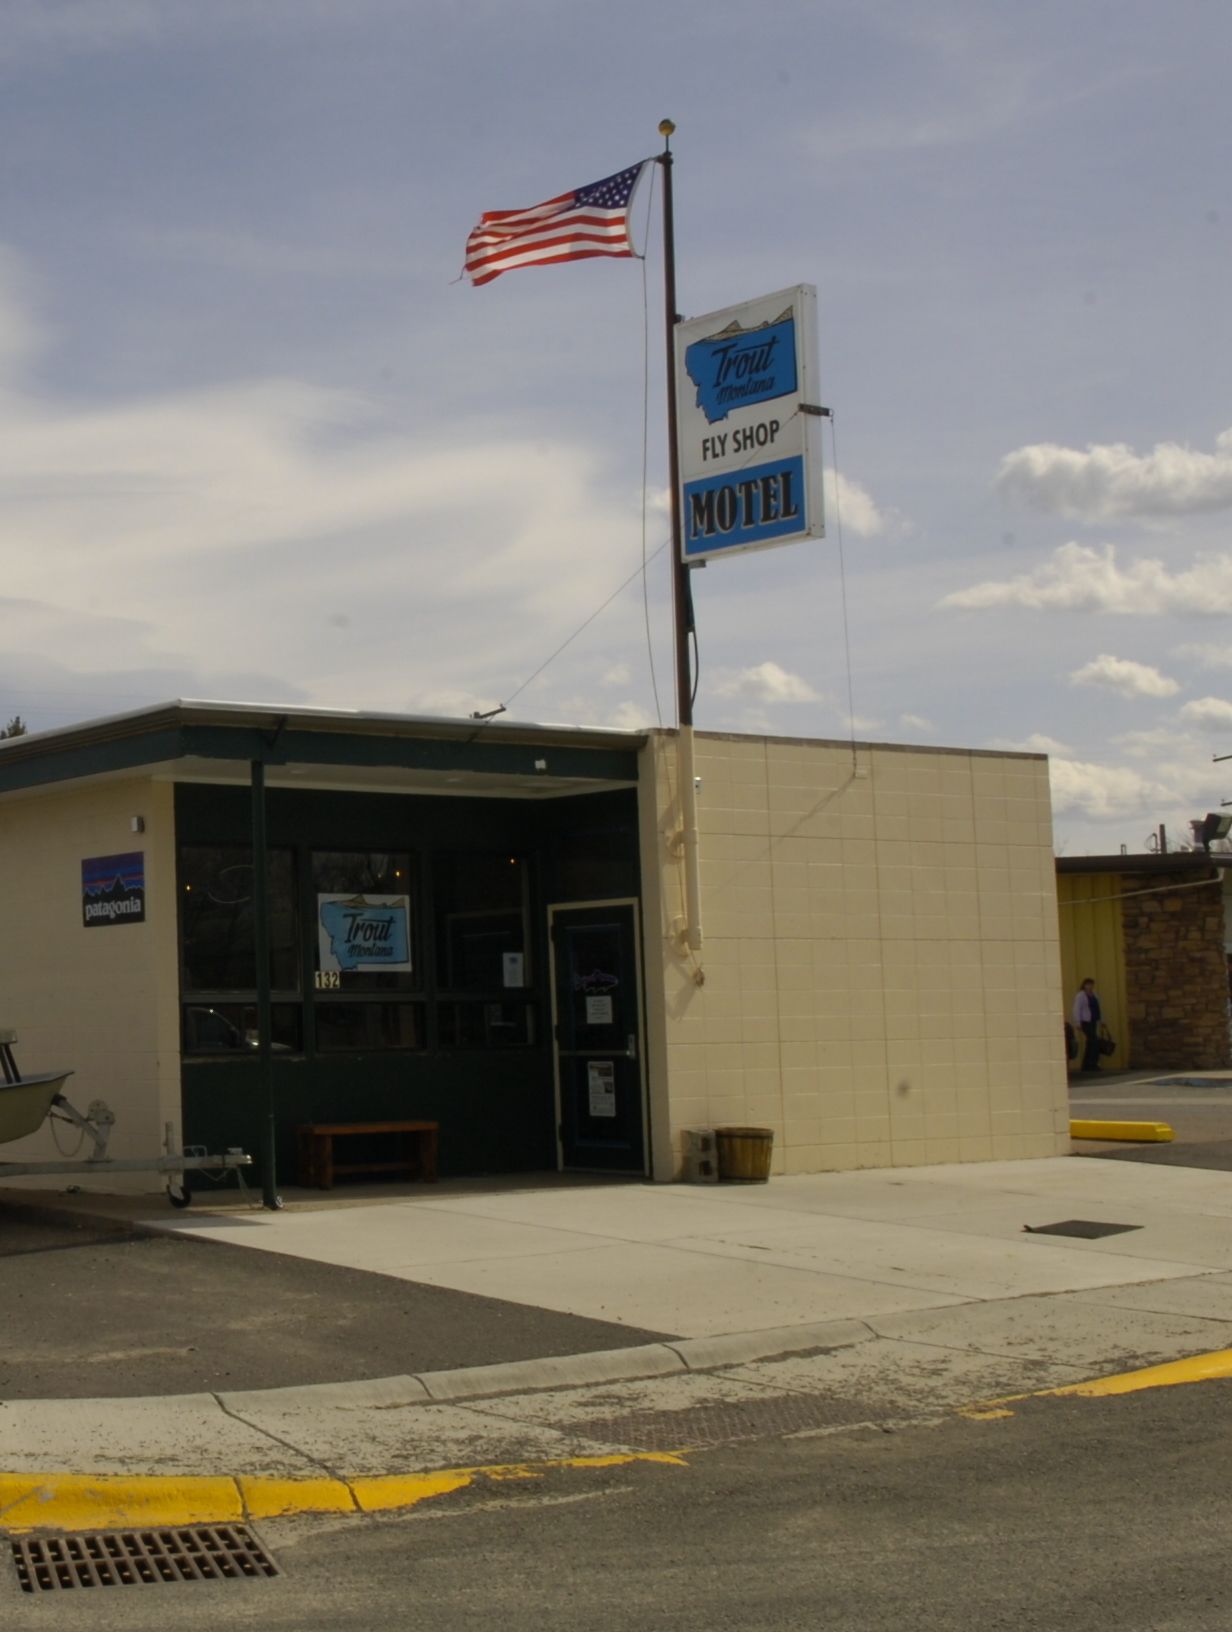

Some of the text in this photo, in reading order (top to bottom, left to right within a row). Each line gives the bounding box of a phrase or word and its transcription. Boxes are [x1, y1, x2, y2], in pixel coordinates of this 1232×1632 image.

[711, 335, 780, 389] Trout
[716, 376, 775, 405] Montana
[702, 419, 780, 461] FLY SHOP
[689, 470, 800, 539] MOTEL
[85, 896, 142, 921] patagonia
[342, 913, 396, 943] Trout
[347, 943, 394, 958] Montana
[316, 972, 339, 988] 132
